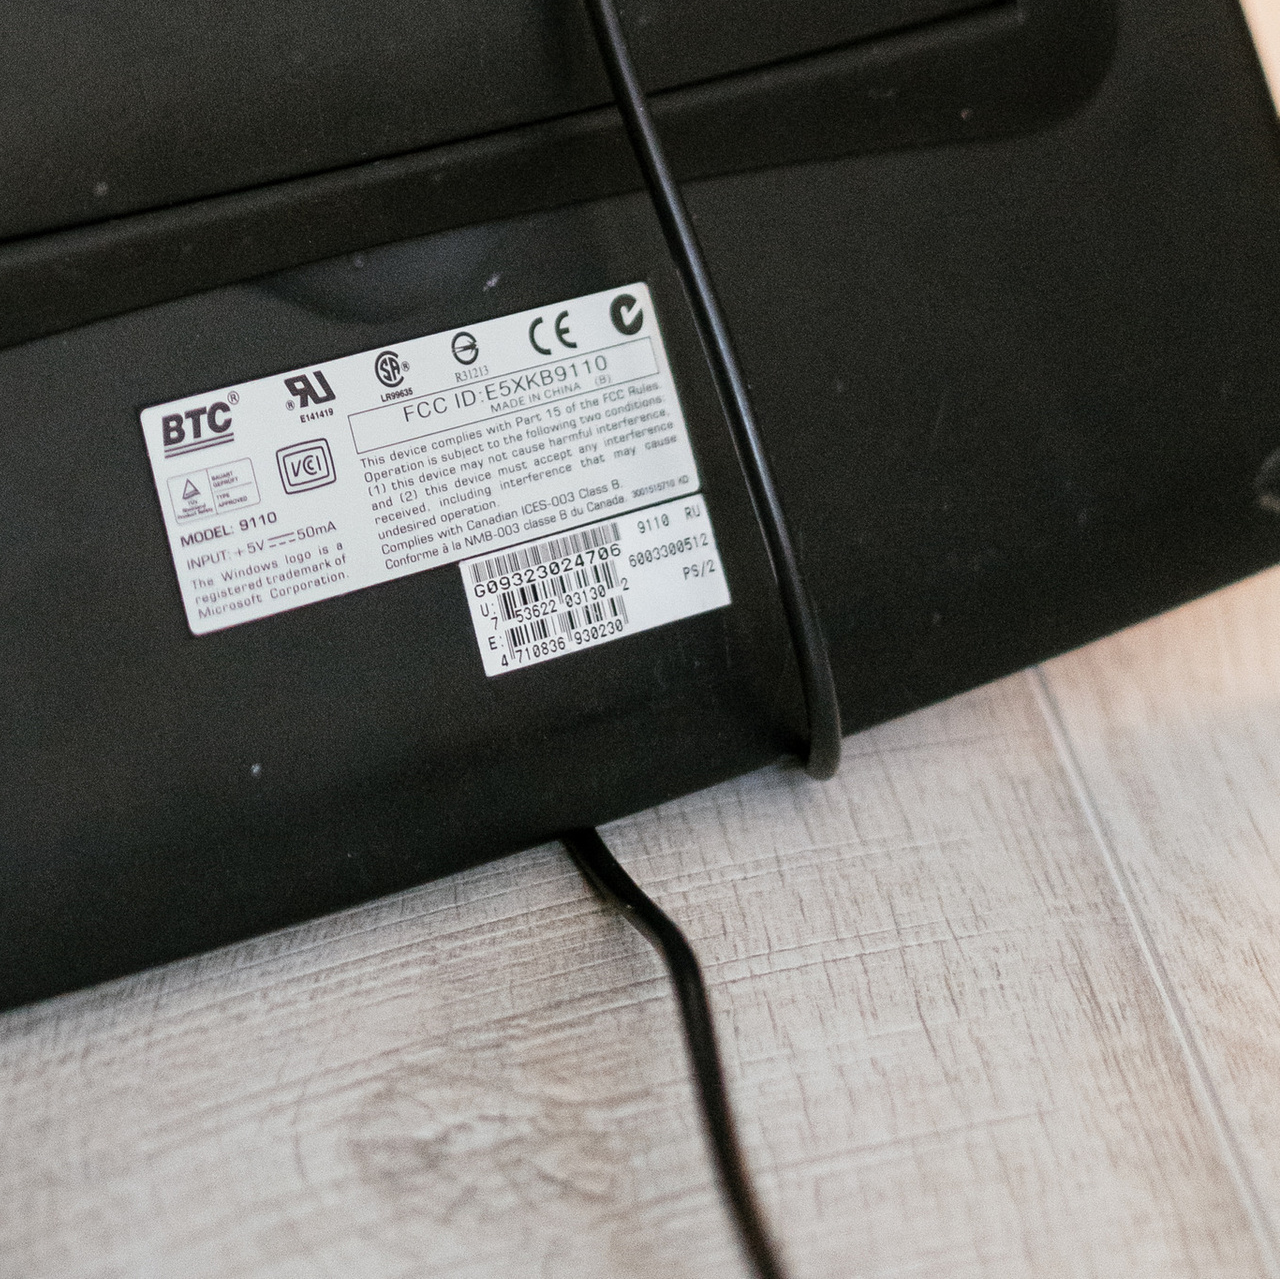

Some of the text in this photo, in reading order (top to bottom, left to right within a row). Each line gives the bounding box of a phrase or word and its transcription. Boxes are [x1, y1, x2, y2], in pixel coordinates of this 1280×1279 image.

[528, 310, 578, 356] CE
[380, 387, 414, 403] LR99635
[454, 364, 489, 383] R31213
[490, 374, 612, 413] MADE IN CHINA (B)
[161, 401, 233, 447] BTC
[299, 407, 334, 424] E141419
[359, 455, 386, 469] This
[389, 444, 428, 462] device
[430, 429, 483, 451] complies
[485, 420, 513, 435] with
[514, 413, 543, 428] Part
[545, 405, 562, 419] 15
[564, 401, 577, 415] of
[579, 398, 600, 410] the
[602, 388, 625, 404] FCC
[402, 396, 448, 423] FCC
[363, 460, 425, 484] Operation
[427, 456, 438, 466] is
[440, 443, 485, 463] subject
[486, 439, 501, 450] to
[502, 433, 524, 446] the
[525, 418, 578, 439] following
[578, 412, 602, 425] two
[367, 482, 387, 497] (1)
[390, 477, 415, 491] this
[418, 466, 457, 484] device
[459, 459, 484, 472] may
[487, 451, 509, 464] not
[511, 442, 546, 458] cause
[548, 426, 593, 448] harmful
[371, 421, 674, 512] and (2) this device must accept any interference
[374, 434, 678, 525] received, including interference that may cause
[180, 511, 278, 548] MODEL: 9110
[377, 500, 501, 541] undesired operation.
[381, 478, 623, 556] Complies with Canadian ICES-003 Class B.
[384, 495, 628, 571] Conforme à la NMB-003 classe B du Canada.
[636, 506, 701, 535] 9110 RU
[186, 549, 232, 571] INPUT:
[296, 520, 337, 541] 50mA
[191, 542, 344, 590] The Windows logo is a
[628, 532, 709, 568] 6003300512
[195, 553, 346, 605] registered trademark of
[473, 542, 622, 599] G09323024706
[682, 559, 716, 580] PS/2
[197, 571, 350, 620] Microsoft Corporation.
[479, 602, 496, 618] U:
[490, 577, 630, 631] 7 53622 03130 2
[487, 635, 504, 651] E:
[501, 618, 624, 667] 4 710836 930230
